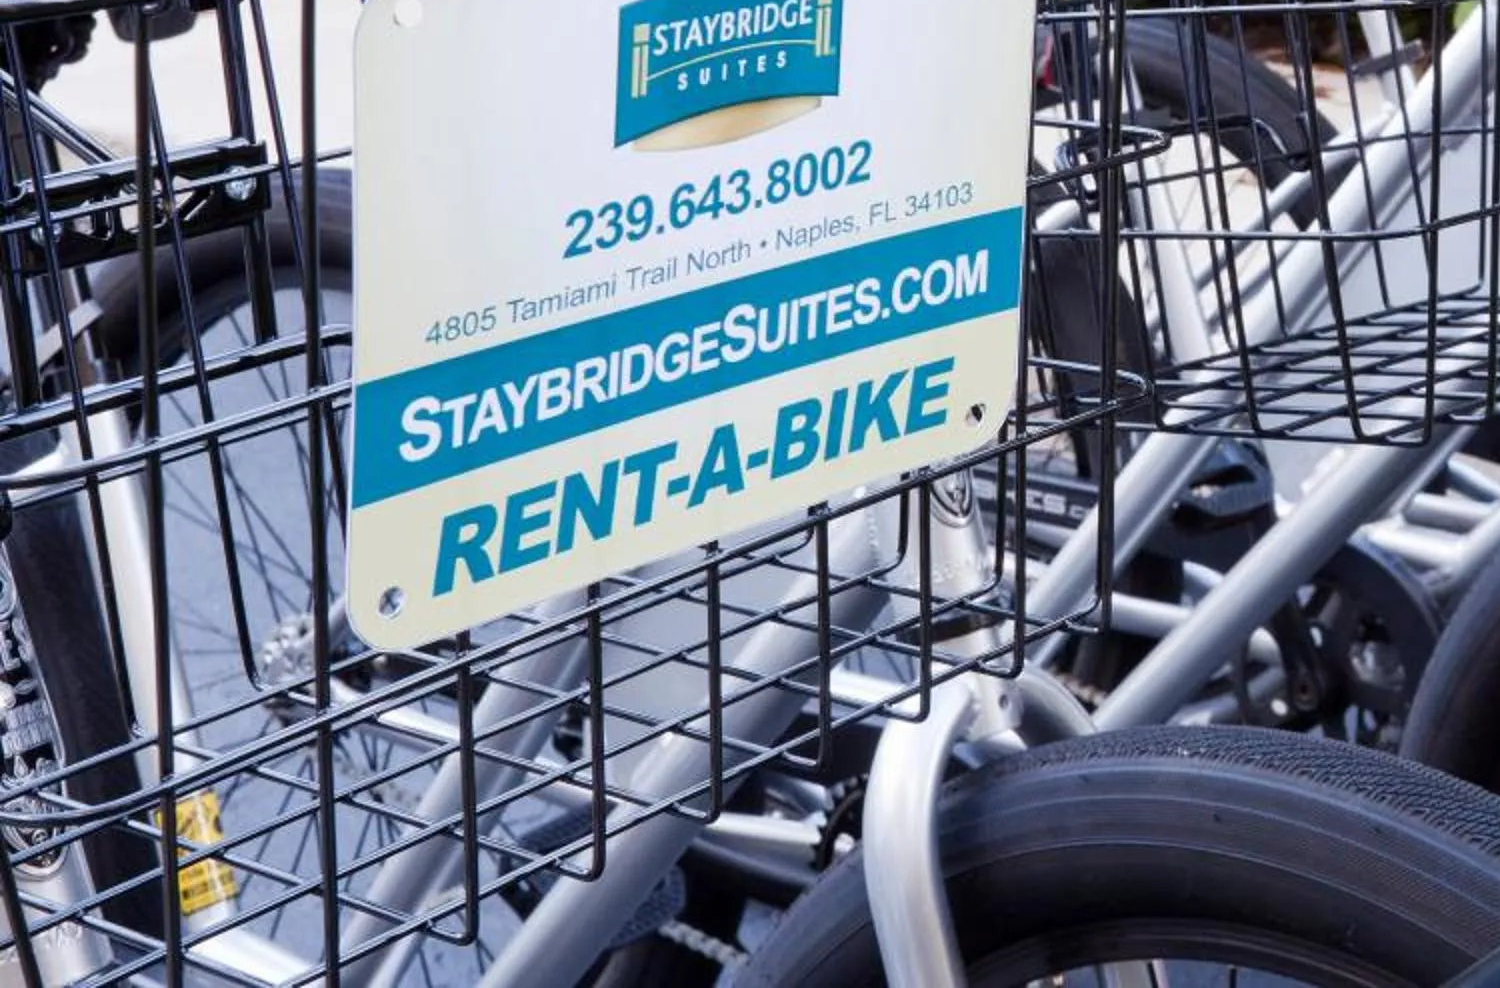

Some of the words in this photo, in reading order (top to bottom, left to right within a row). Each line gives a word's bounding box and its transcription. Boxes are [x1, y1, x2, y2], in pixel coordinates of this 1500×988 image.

[677, 50, 789, 91] SUITES
[424, 304, 498, 347] 4805
[506, 274, 618, 324] Tamiami
[625, 256, 678, 292] Trail
[686, 239, 753, 276] North
[775, 215, 864, 252] Naples,
[869, 200, 898, 226] FL
[904, 181, 975, 217] 34103
[563, 139, 874, 260] 239.643.8002
[398, 248, 990, 463] STAYBRIDGESUITES.COM
[431, 355, 957, 599] RENT-A-BIKE
